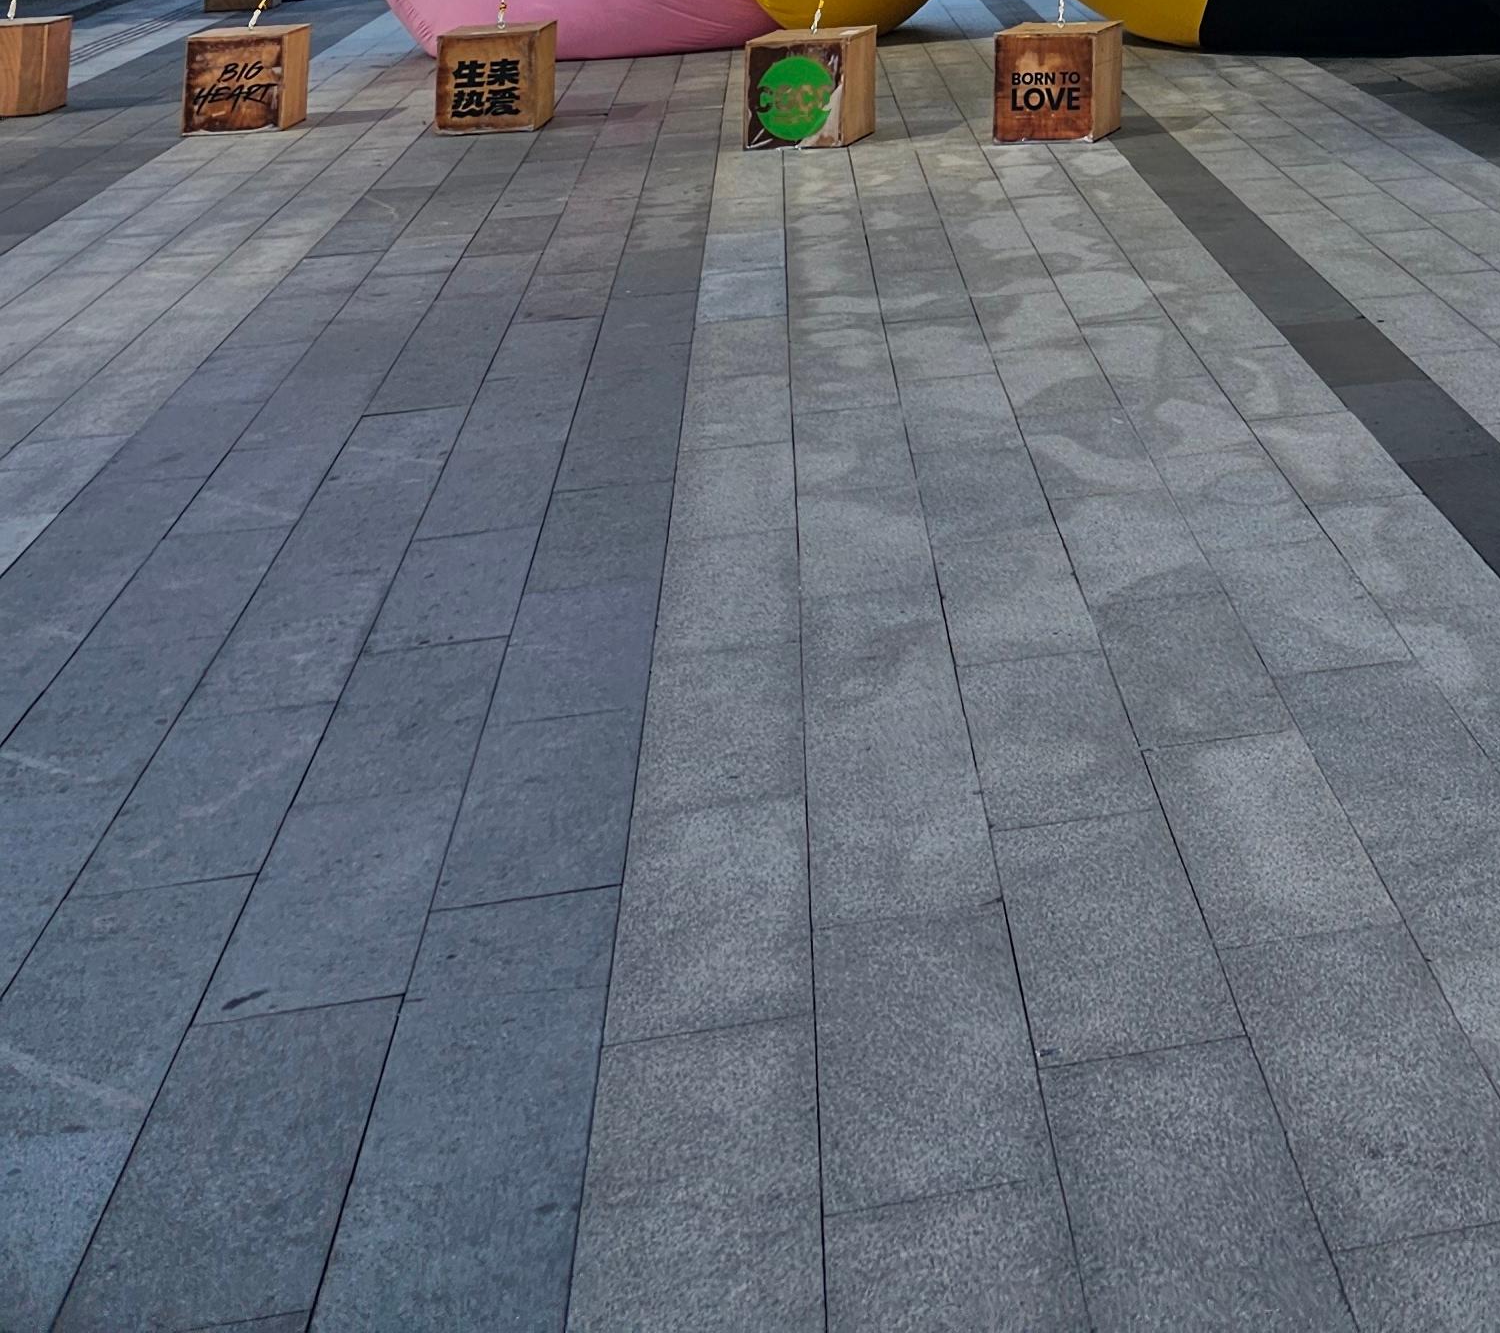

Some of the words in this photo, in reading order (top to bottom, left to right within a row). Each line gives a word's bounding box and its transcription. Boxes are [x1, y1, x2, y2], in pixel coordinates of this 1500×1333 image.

[216, 60, 264, 83] BIG
[452, 58, 521, 89] 生来
[1011, 72, 1055, 85] BORN
[1060, 71, 1080, 85] TO
[192, 82, 278, 115] HEART
[450, 86, 522, 119] 热爱
[1011, 87, 1080, 111] LOVE
